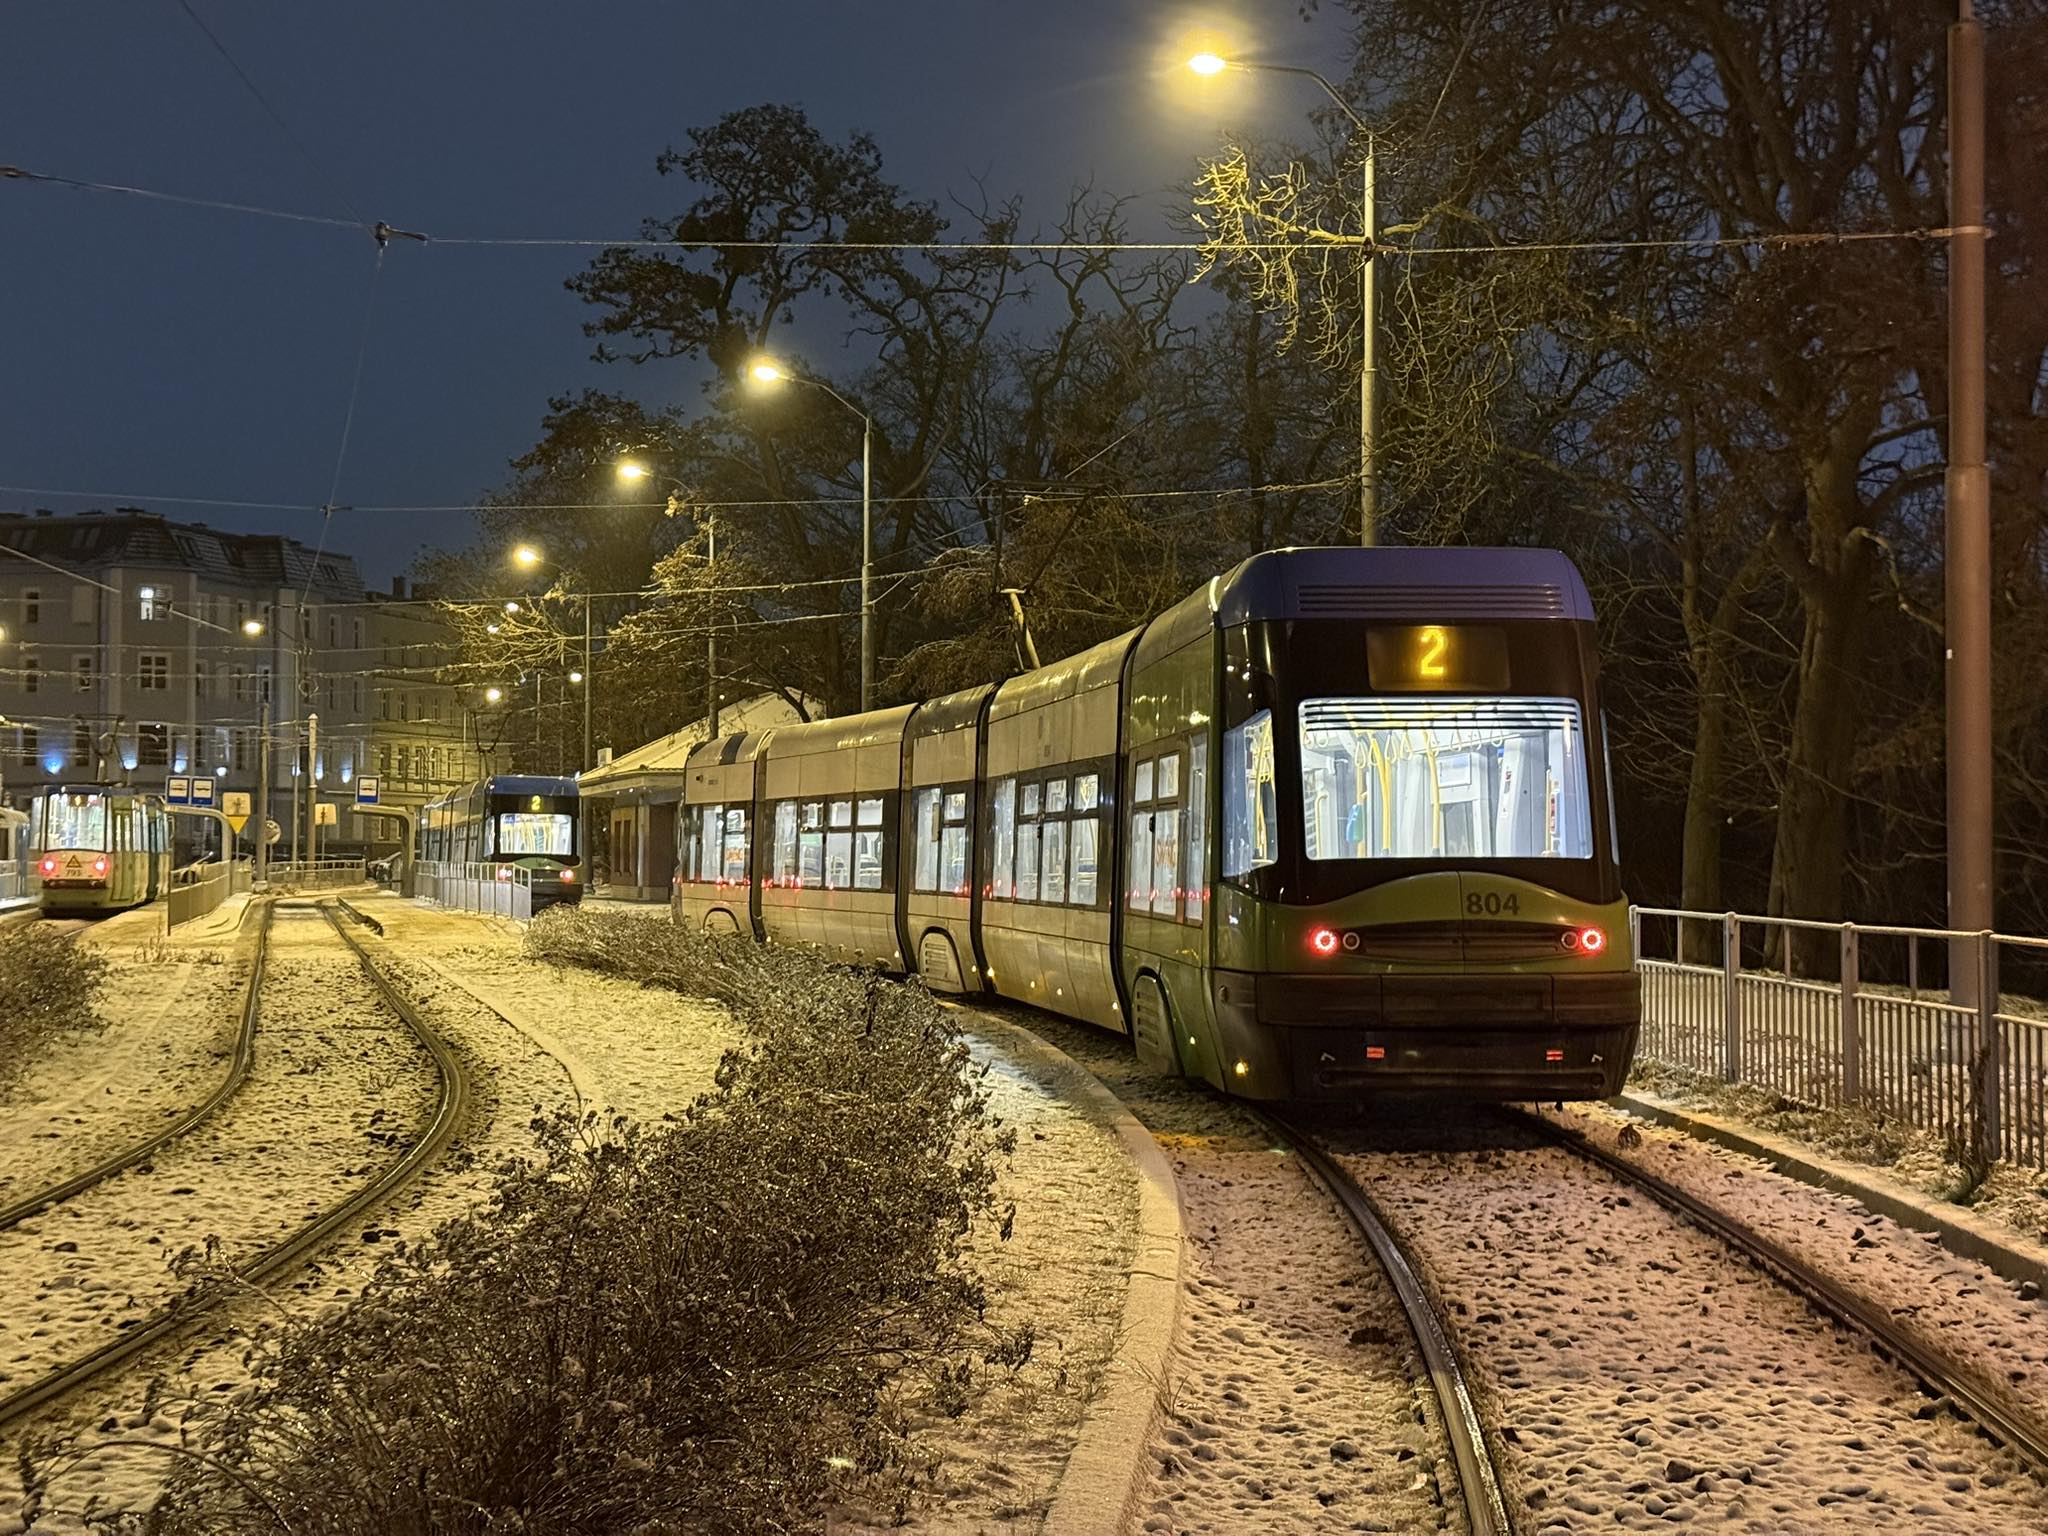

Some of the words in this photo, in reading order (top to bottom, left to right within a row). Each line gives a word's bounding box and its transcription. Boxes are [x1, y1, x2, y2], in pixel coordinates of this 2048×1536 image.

[1419, 626, 1445, 675] 2
[531, 795, 541, 811] 2
[1466, 892, 1520, 916] 804
